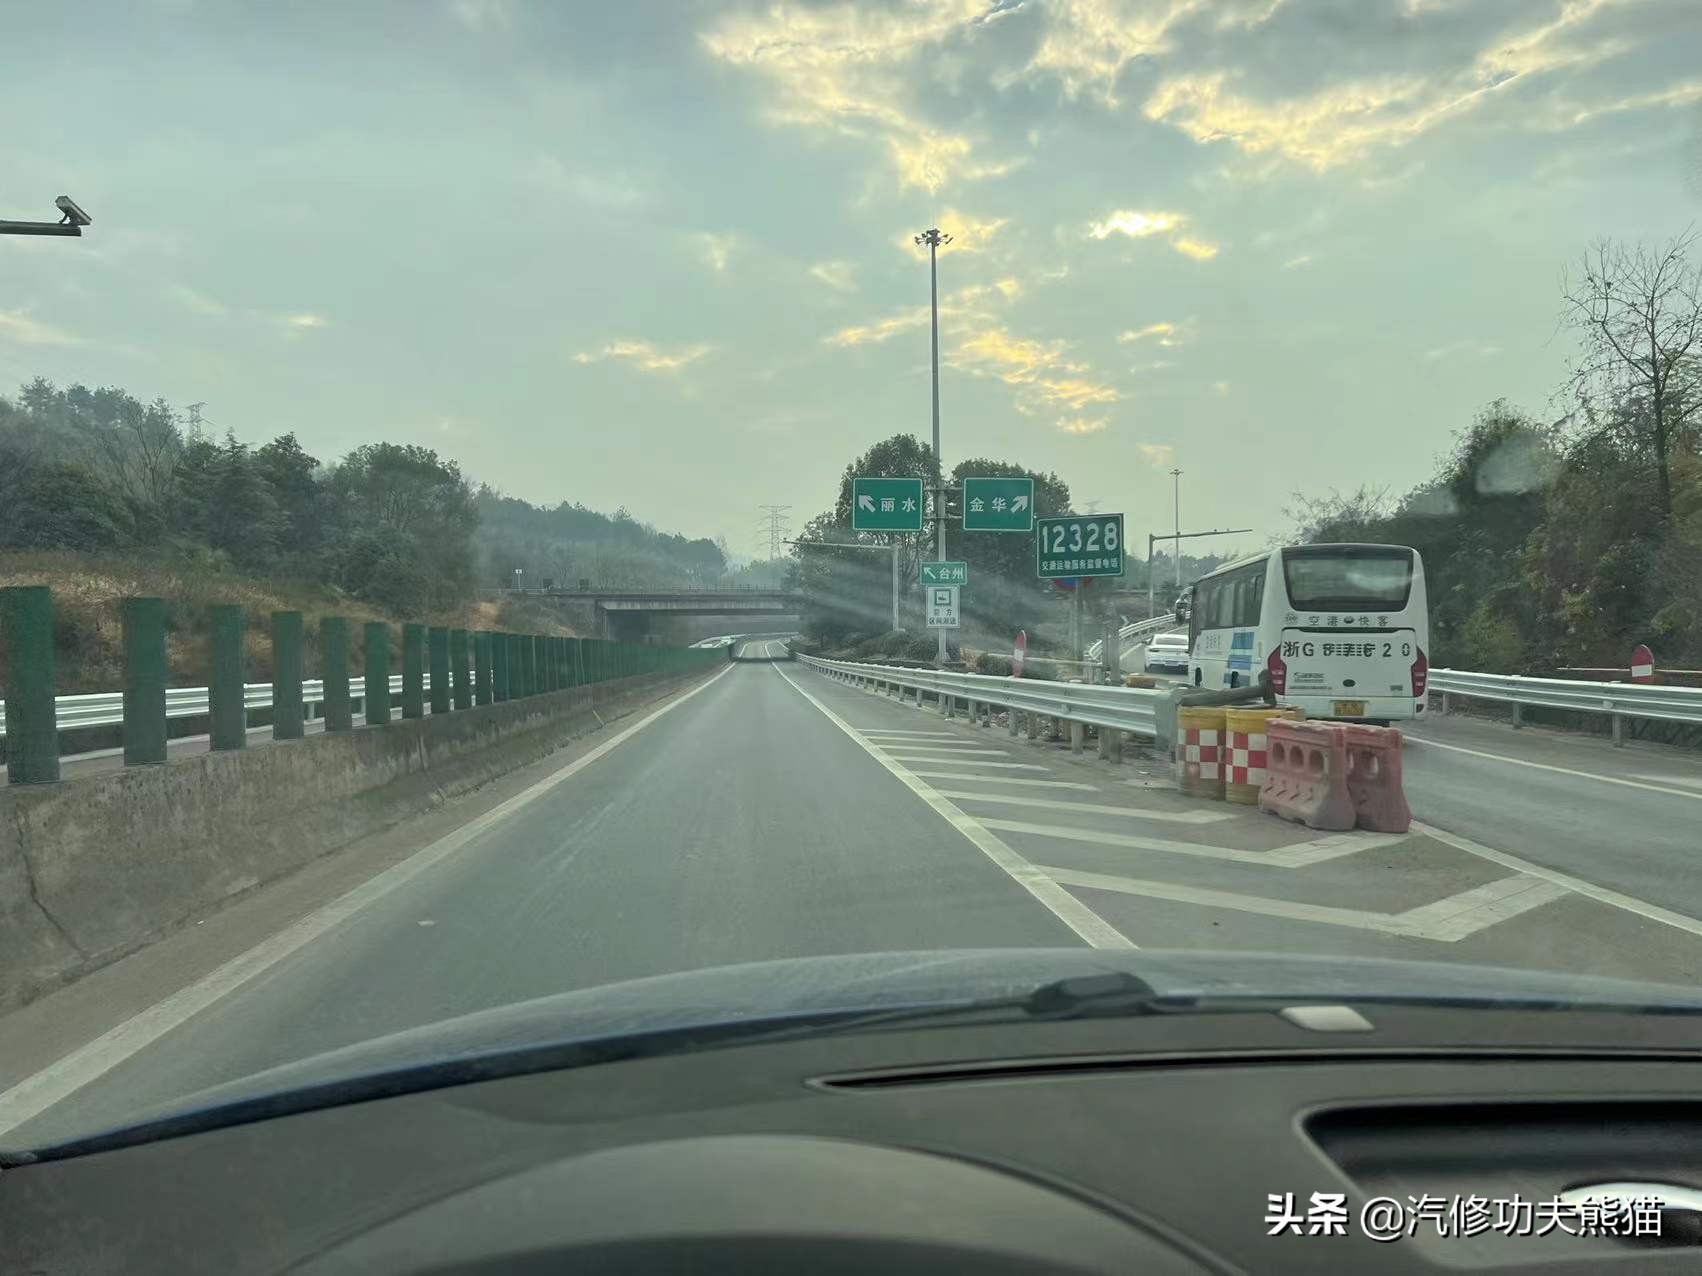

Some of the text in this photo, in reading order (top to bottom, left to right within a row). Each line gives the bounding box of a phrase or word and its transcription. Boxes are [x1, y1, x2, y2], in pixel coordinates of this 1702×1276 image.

[881, 497, 917, 513] 丽水
[969, 497, 1008, 513] 金华
[1042, 522, 1118, 554] 12328
[939, 567, 964, 580] 台州
